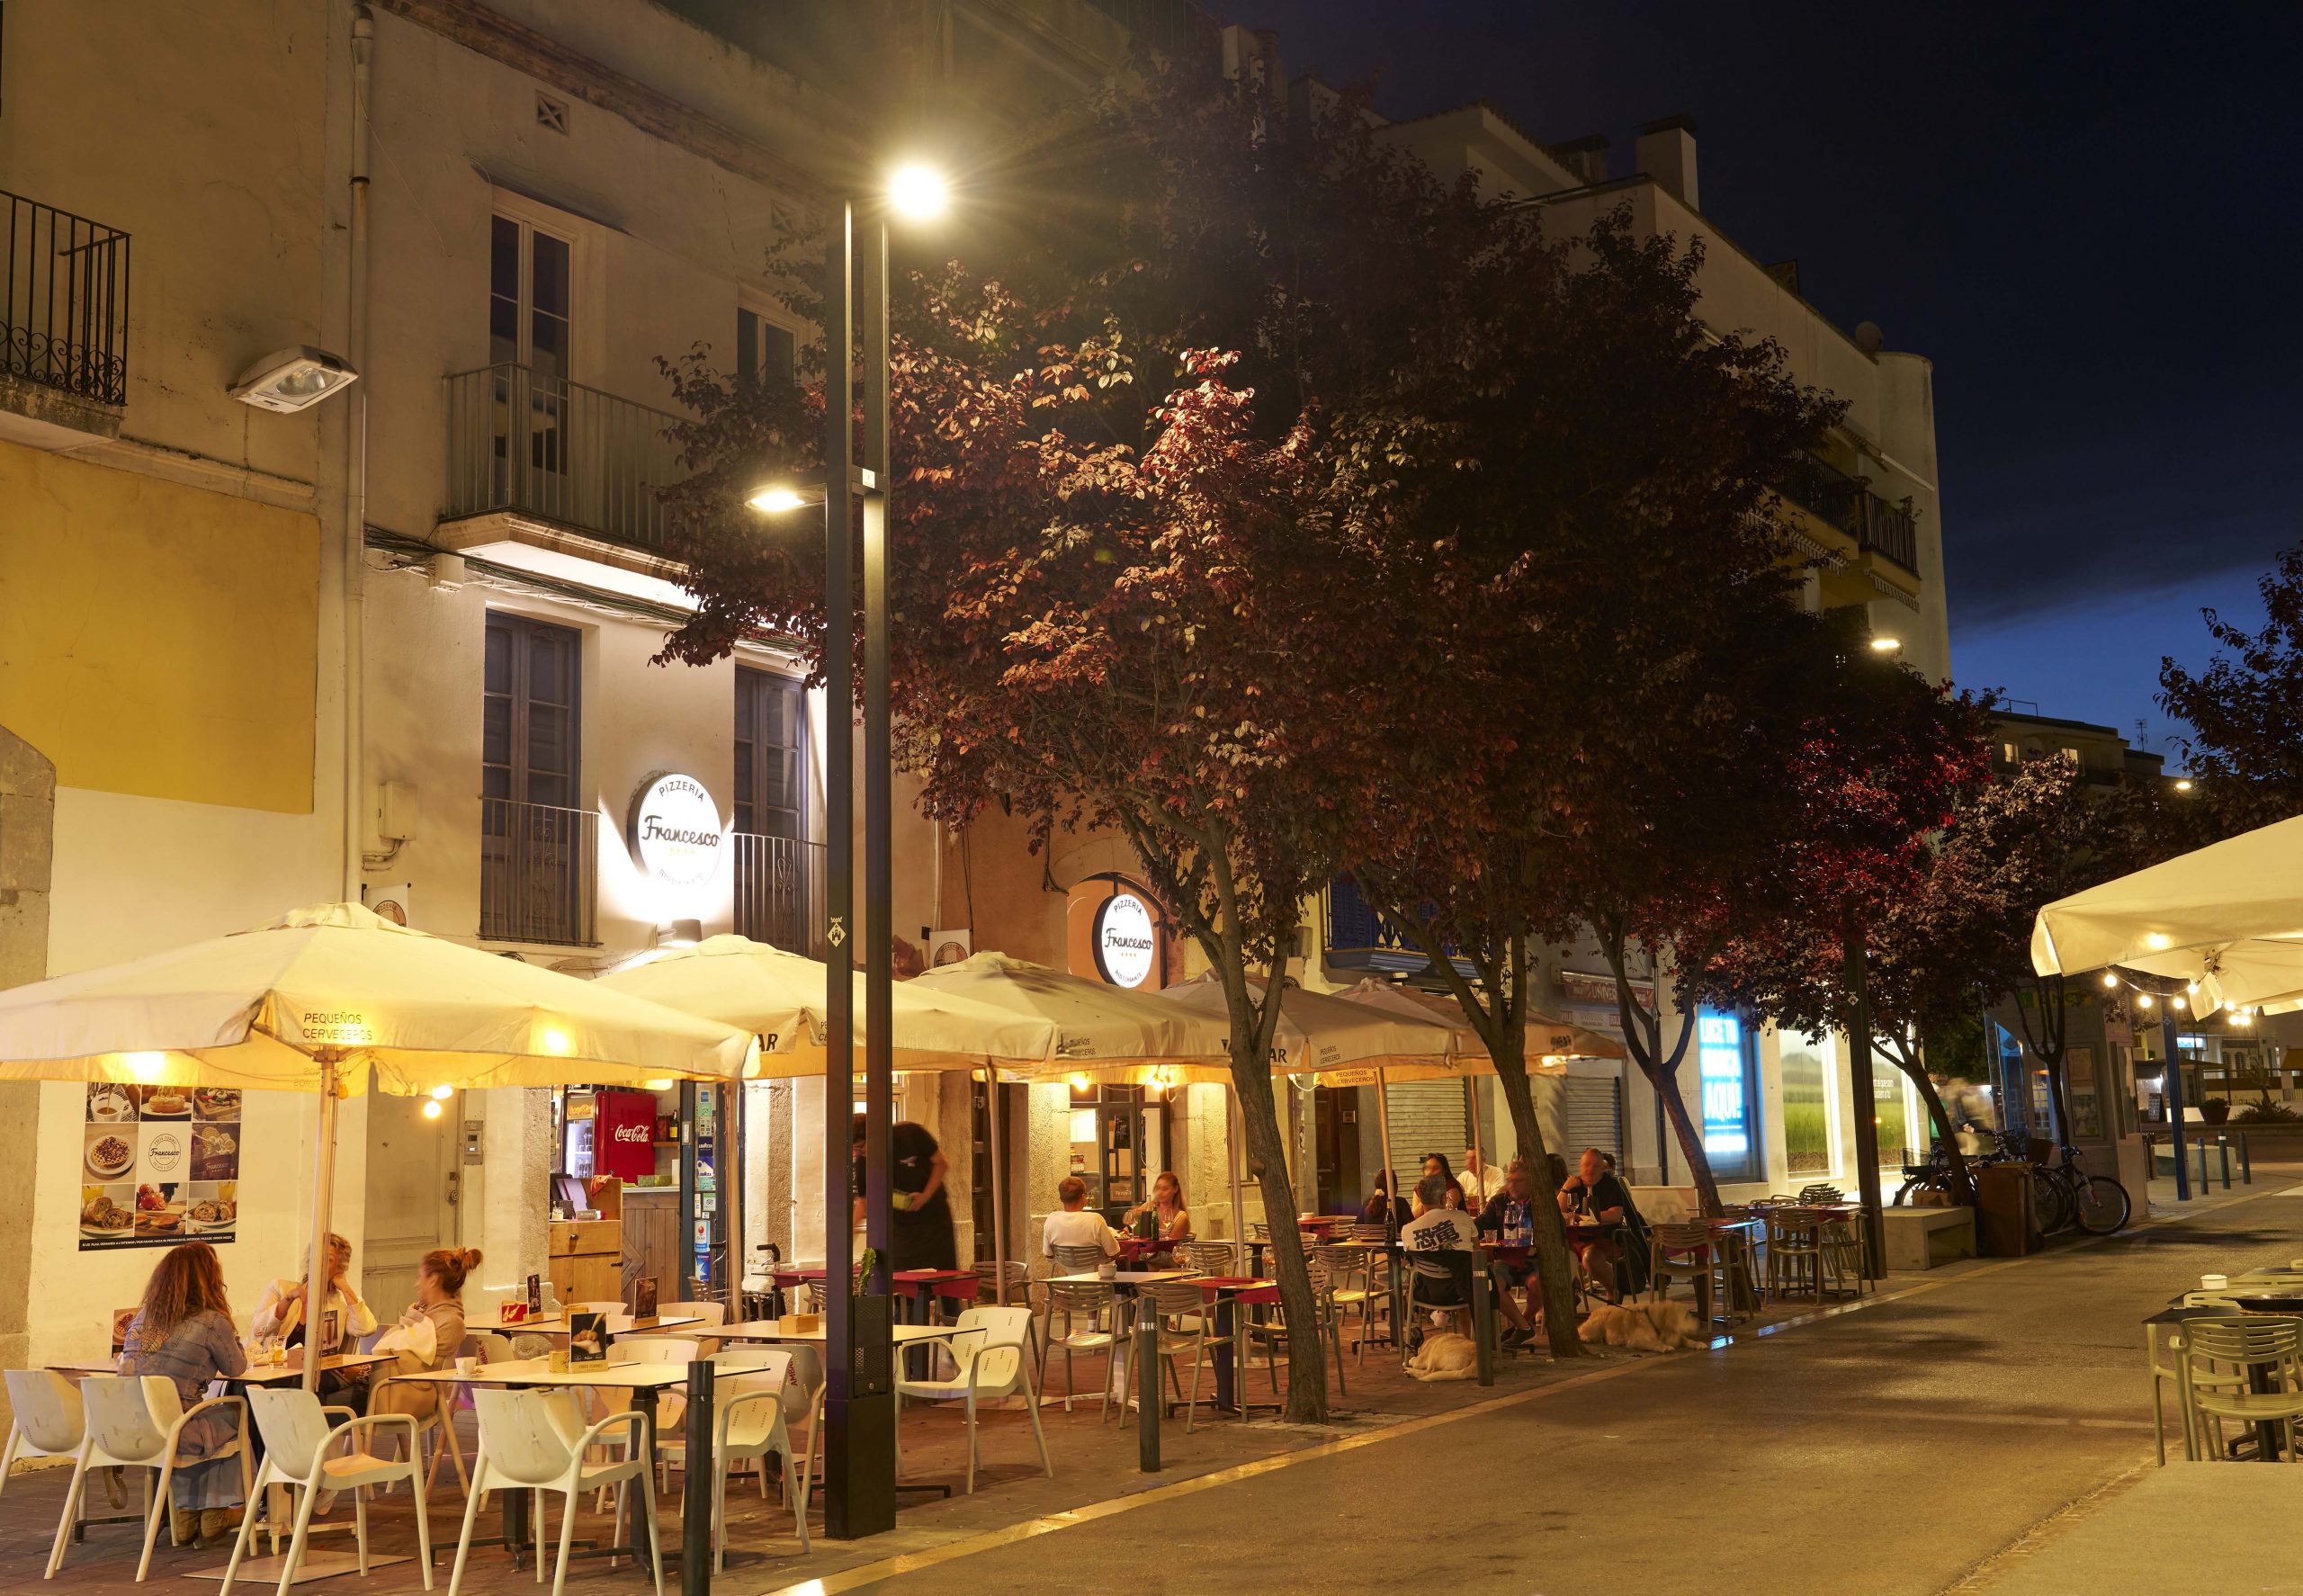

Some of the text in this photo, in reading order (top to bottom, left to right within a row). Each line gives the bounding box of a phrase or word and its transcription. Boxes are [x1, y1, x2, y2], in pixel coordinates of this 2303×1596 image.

[659, 780, 704, 802] PIZZERIA
[641, 814, 721, 847] Francesco
[1114, 899, 1142, 916] PIZZERIA
[1105, 928, 1153, 950] Francesco
[303, 1011, 362, 1025] PEQUEÑOS
[302, 1028, 372, 1041] CERVECEROS
[149, 1147, 180, 1157] Francesco
